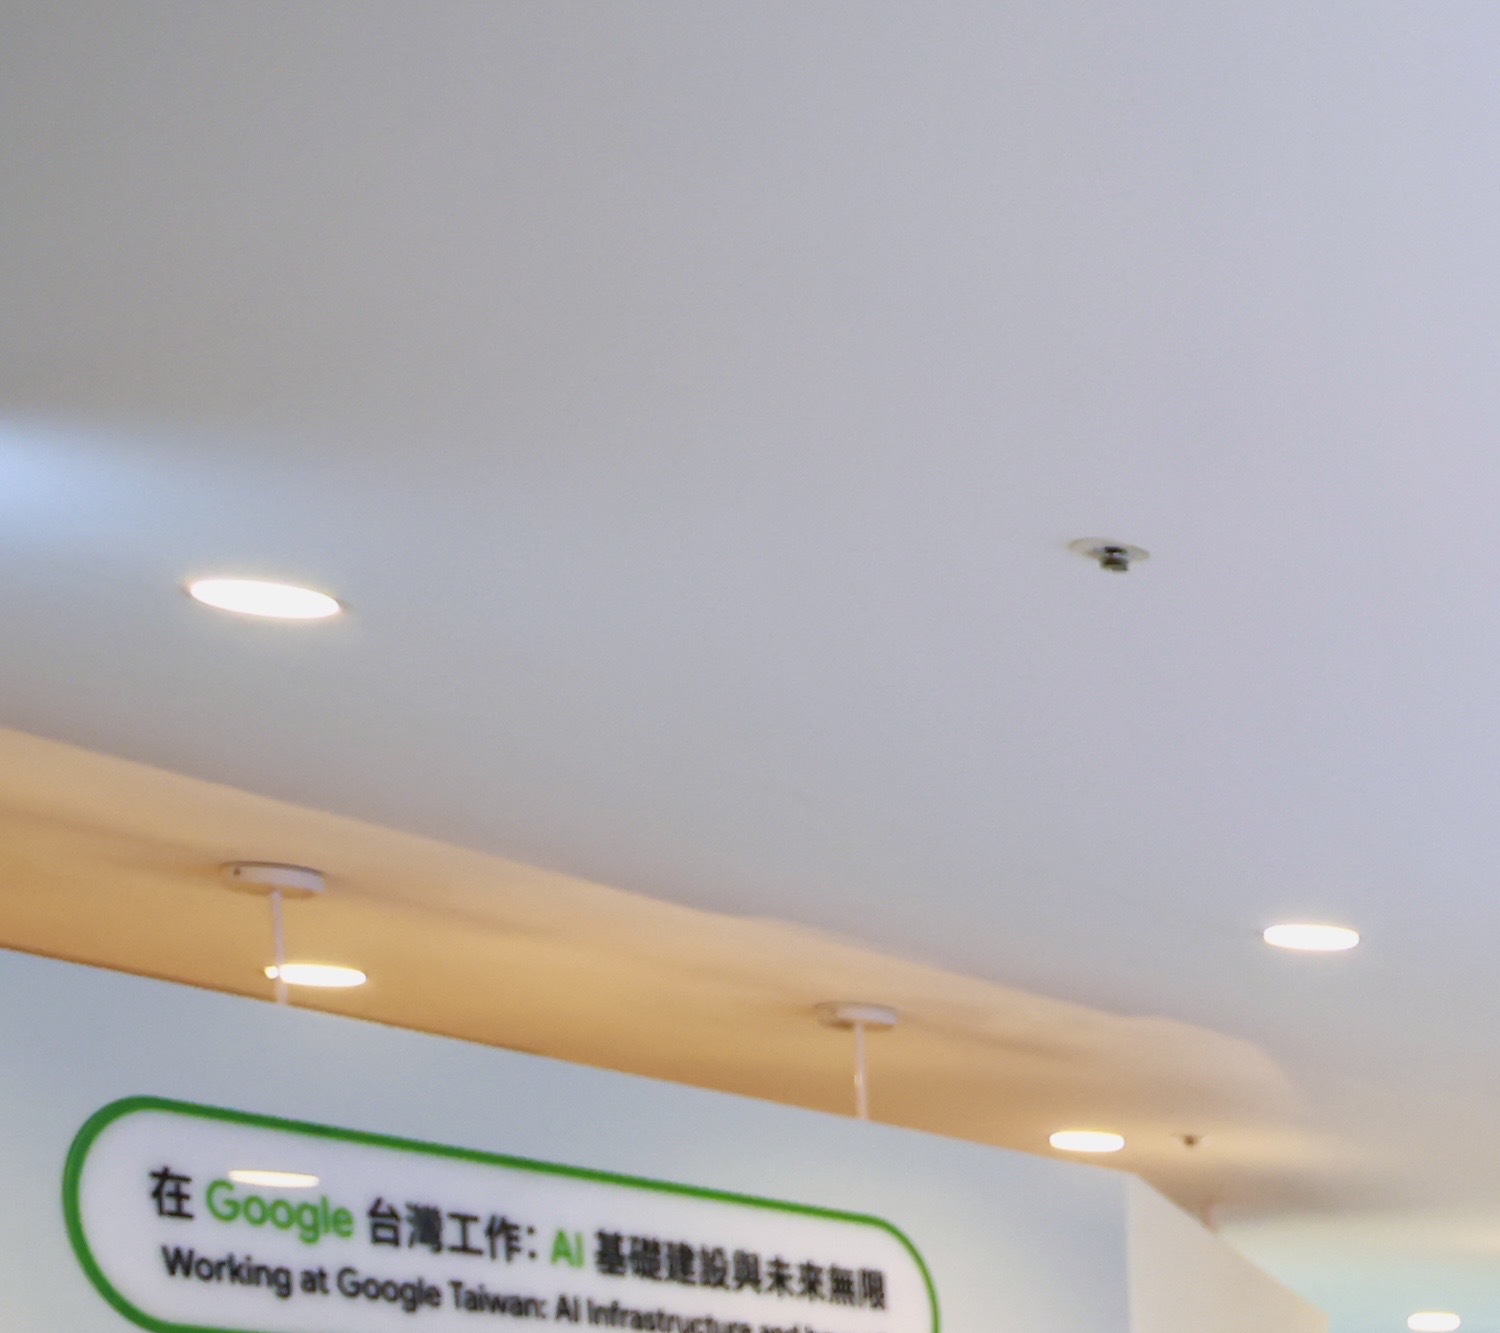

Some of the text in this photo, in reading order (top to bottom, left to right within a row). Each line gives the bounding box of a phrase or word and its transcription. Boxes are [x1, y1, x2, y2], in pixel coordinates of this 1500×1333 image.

[149, 1166, 194, 1221] 在
[204, 1179, 354, 1244] Google
[550, 1228, 581, 1269] AI
[160, 1244, 292, 1300] Working
[299, 1267, 329, 1296] at
[336, 1266, 442, 1313] Google
[449, 1280, 546, 1320] Taiwan:
[554, 1297, 580, 1324] AI
